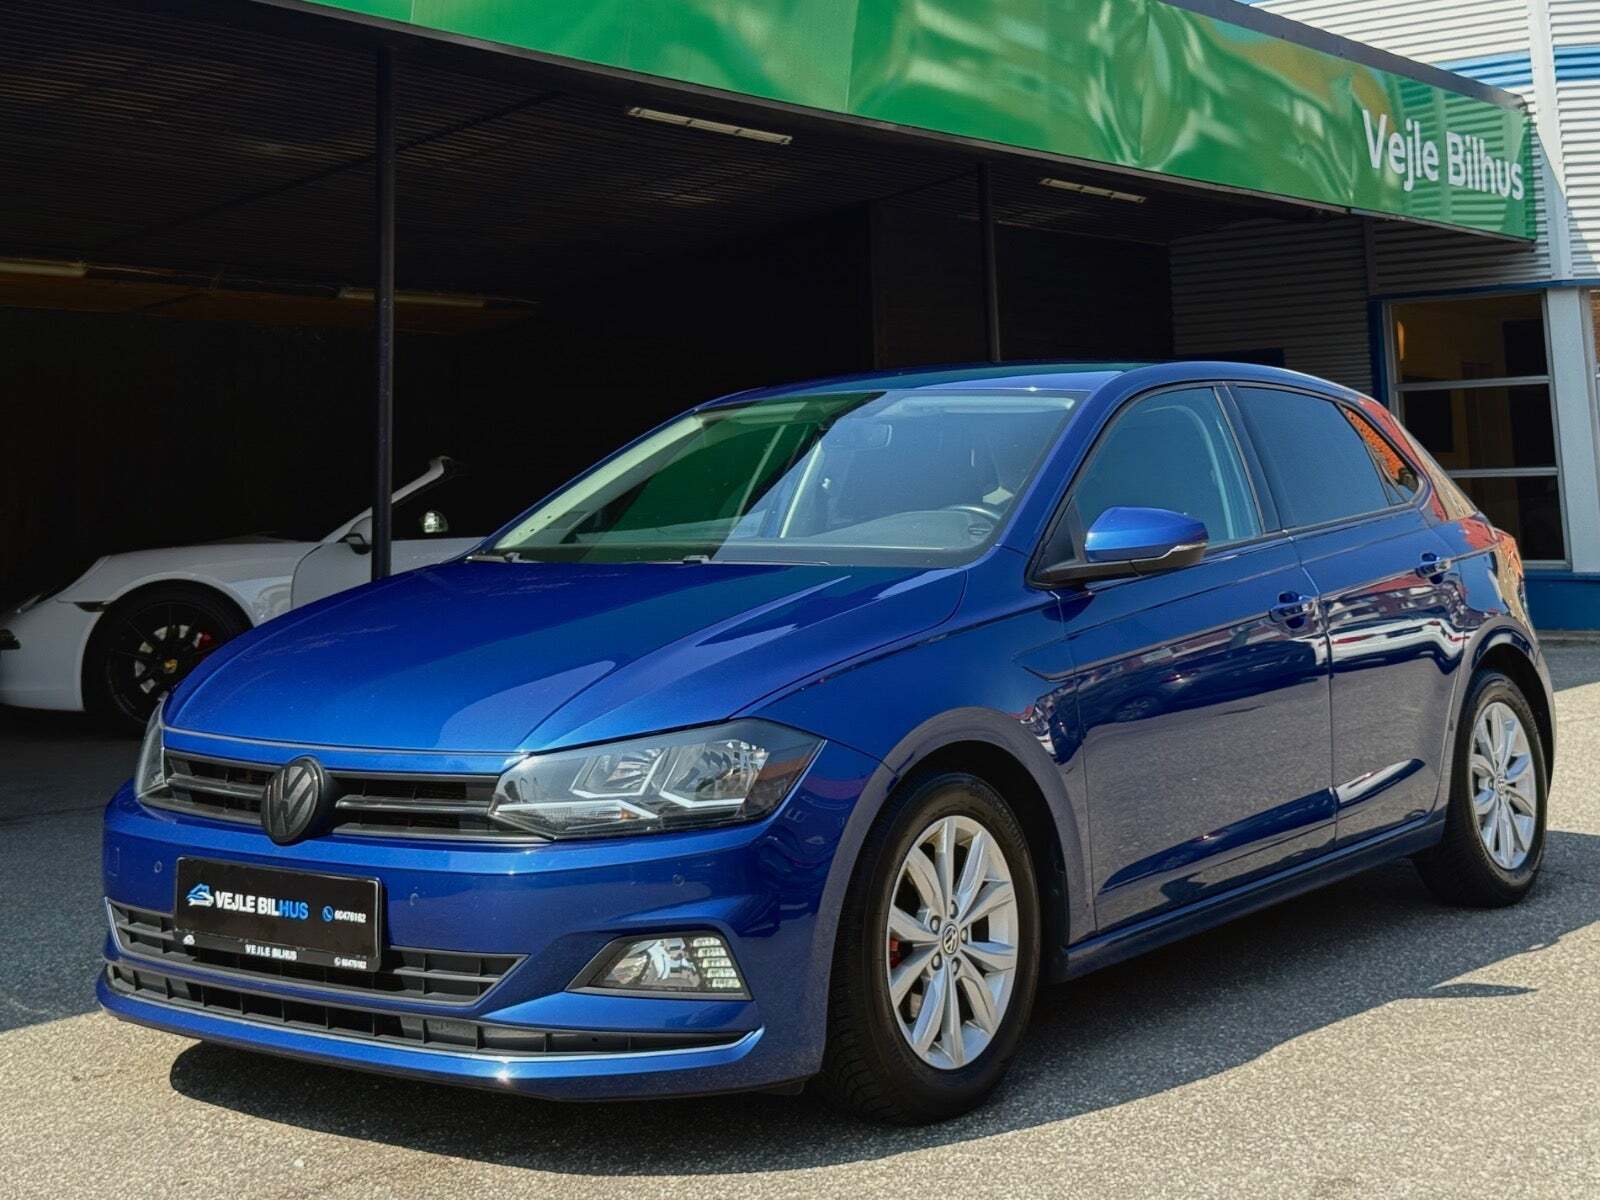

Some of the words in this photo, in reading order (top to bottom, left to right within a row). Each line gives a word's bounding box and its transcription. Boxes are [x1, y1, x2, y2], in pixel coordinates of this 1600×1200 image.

[1362, 109, 1440, 192] Vejle
[1446, 131, 1525, 200] Bilhus
[214, 891, 256, 914] VEJLE
[257, 897, 309, 919] BILHUS
[245, 943, 271, 956] VEJLE
[271, 948, 298, 961] BILHUS
